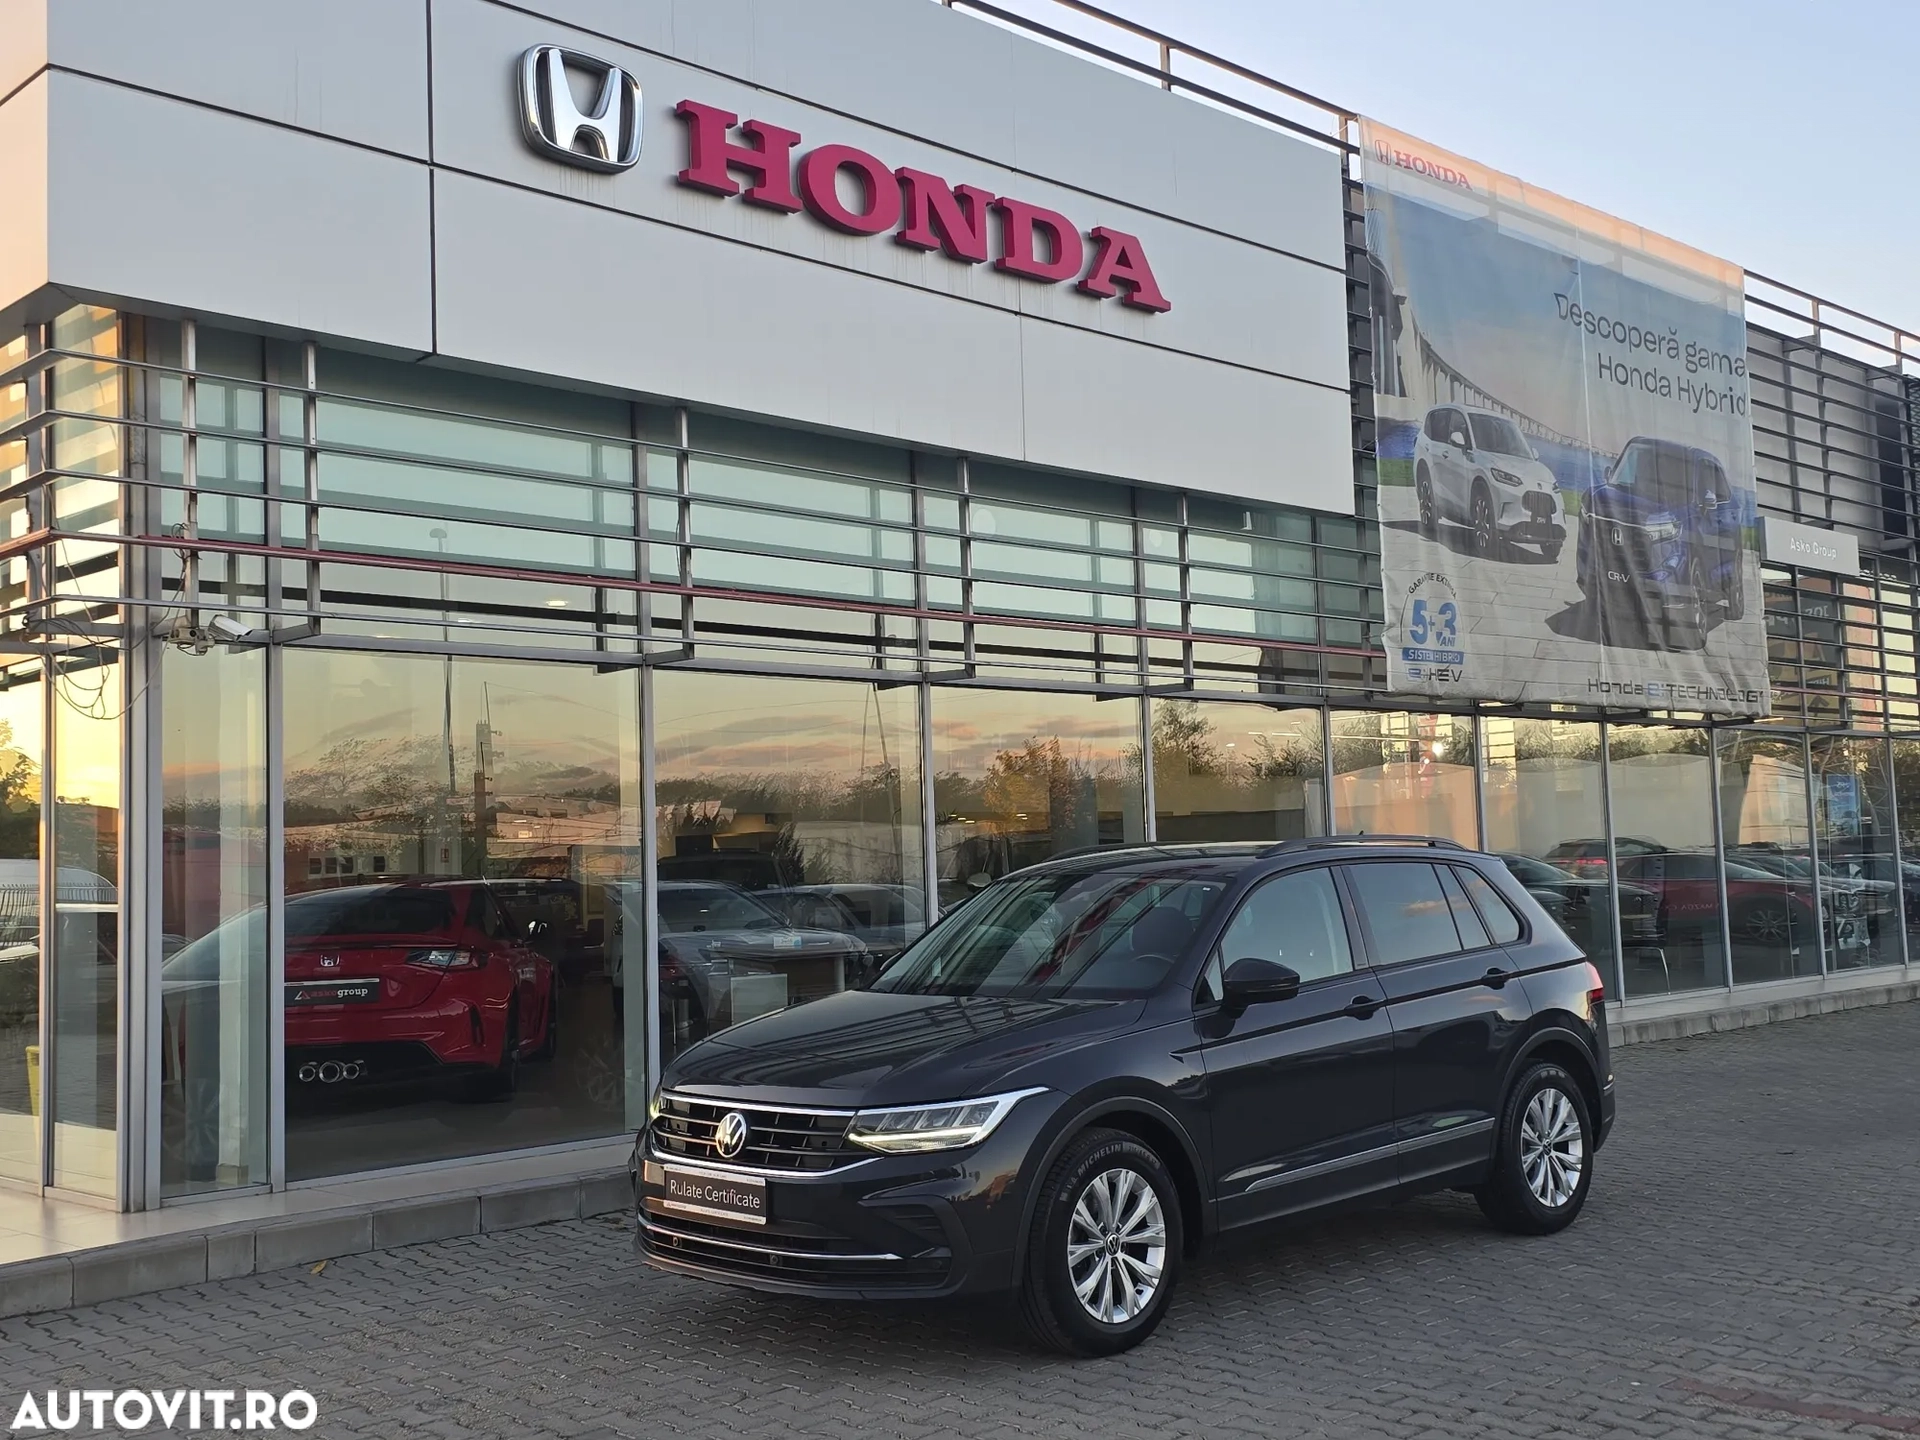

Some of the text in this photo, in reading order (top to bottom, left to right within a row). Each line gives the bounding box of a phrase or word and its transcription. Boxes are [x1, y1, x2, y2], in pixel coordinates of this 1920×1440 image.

[1393, 150, 1473, 191] HONDA
[676, 99, 1171, 313] HONDA
[1553, 293, 1746, 377] Descoperă gama
[1598, 352, 1746, 418] Honda Hybrid
[1789, 537, 1837, 561] Asko Group
[1607, 570, 1631, 583] CR-V
[1408, 649, 1433, 661] SISTE
[1440, 635, 1456, 647] ANI
[1588, 678, 1644, 695] Honda
[1077, 1143, 1122, 1176] MICHELIN
[670, 1179, 761, 1209] Rulate Certificate
